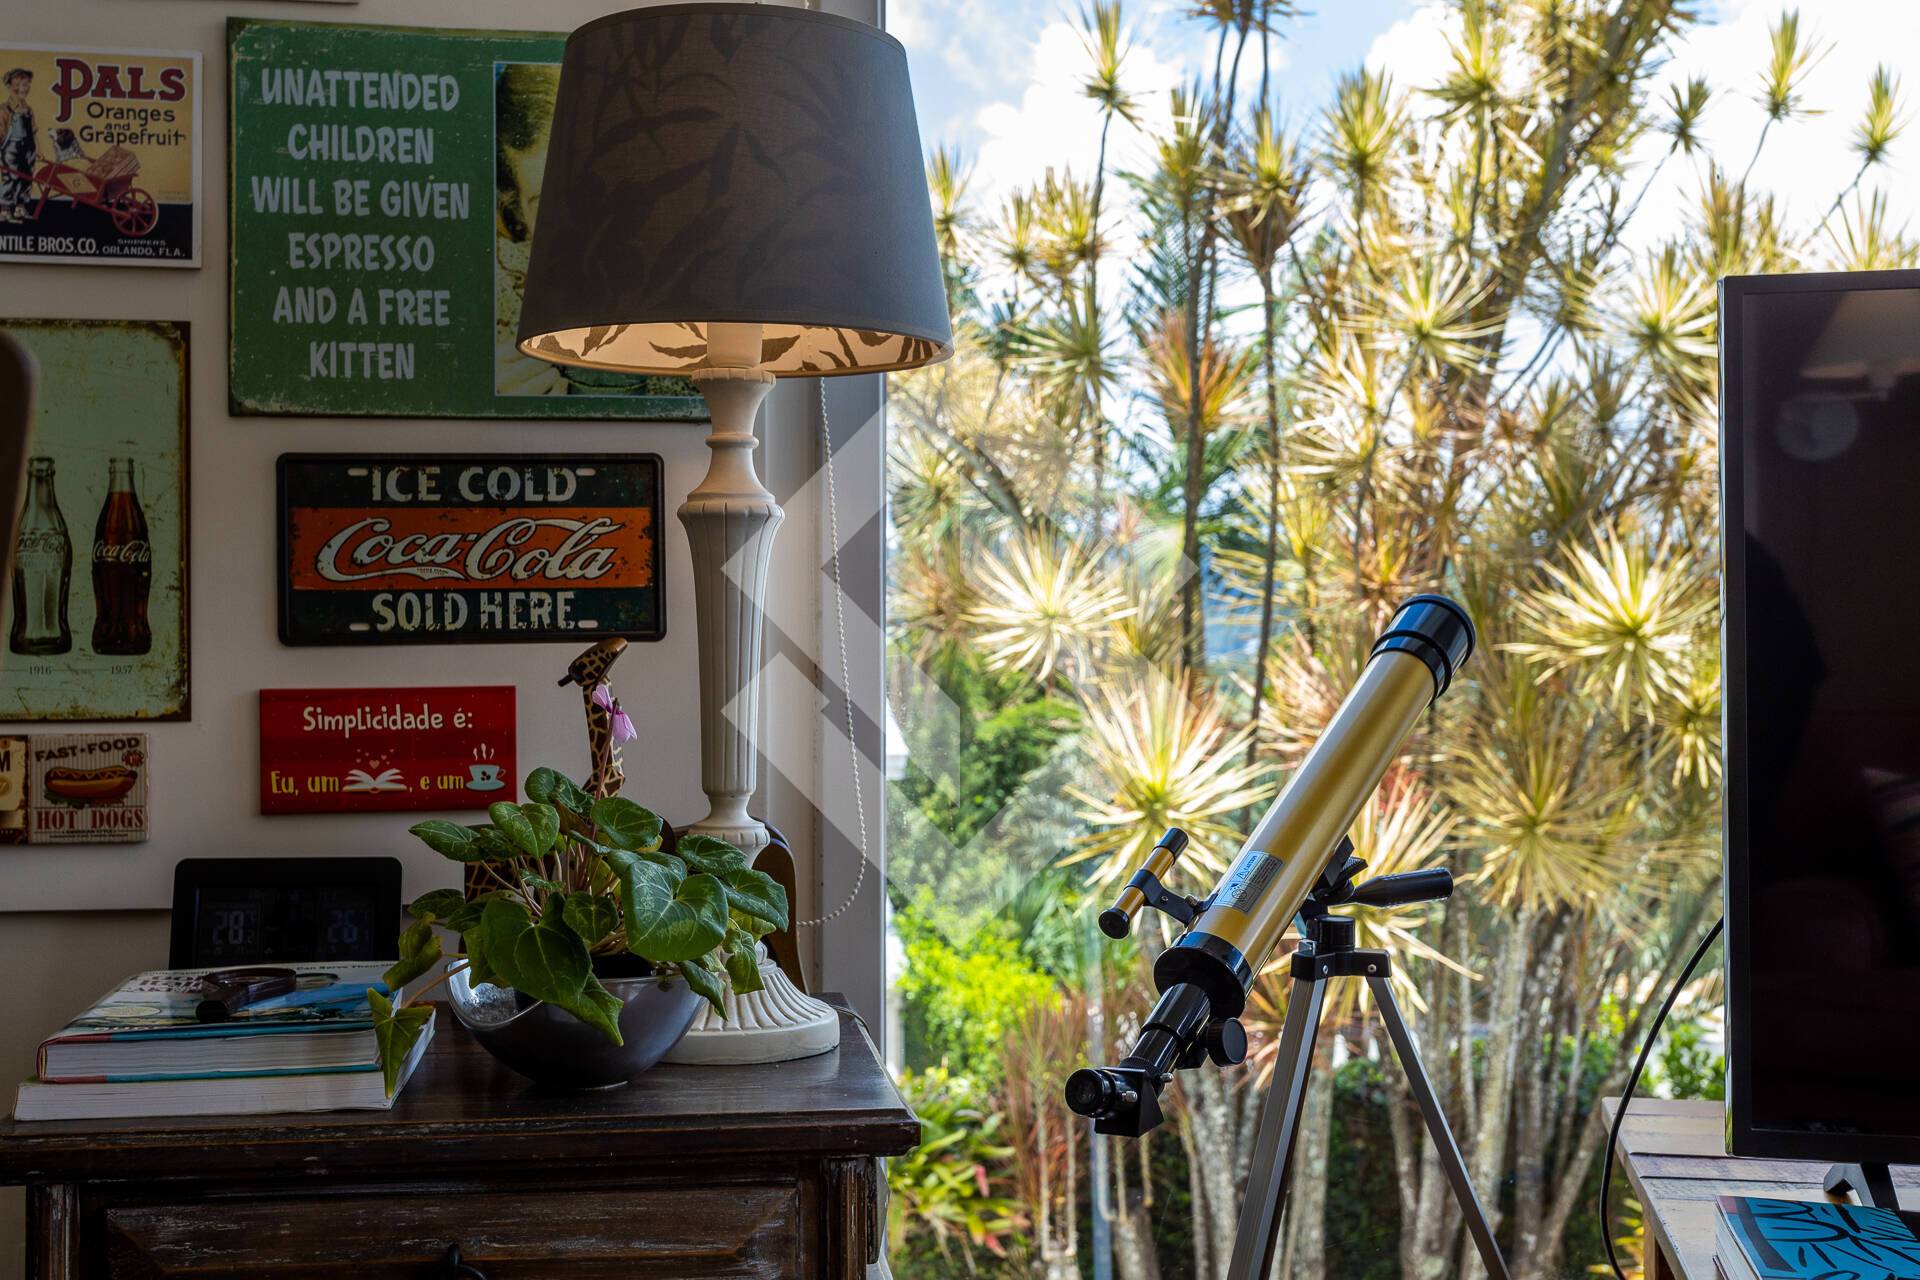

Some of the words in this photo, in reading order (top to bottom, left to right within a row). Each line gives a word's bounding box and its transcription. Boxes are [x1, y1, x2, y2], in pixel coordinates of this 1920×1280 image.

[51, 58, 186, 122] PALS
[261, 67, 460, 112] UNATTENDED
[86, 102, 176, 127] Oranges
[105, 123, 130, 131] and
[79, 125, 186, 146] Grapefruit
[287, 124, 434, 165] CHILDREN
[251, 176, 323, 215] WILL
[333, 180, 370, 217] BE
[380, 180, 470, 220] GIVEN
[288, 232, 435, 272] ESPRESSO
[272, 286, 337, 325] AND
[347, 287, 367, 325] A
[379, 288, 451, 327] FREE
[309, 341, 415, 380] KITTEN
[372, 466, 441, 502] ICE
[458, 466, 577, 502] COLD
[316, 517, 626, 582] Coca-Cola
[371, 591, 468, 631] SOLD
[479, 590, 576, 630] HERE
[303, 703, 444, 739] Simplicidade
[271, 770, 299, 796] Eu,
[307, 775, 339, 793] um
[420, 775, 430, 790] e
[437, 775, 464, 790] um
[36, 809, 77, 830] HOT
[91, 808, 143, 829] DOGS
